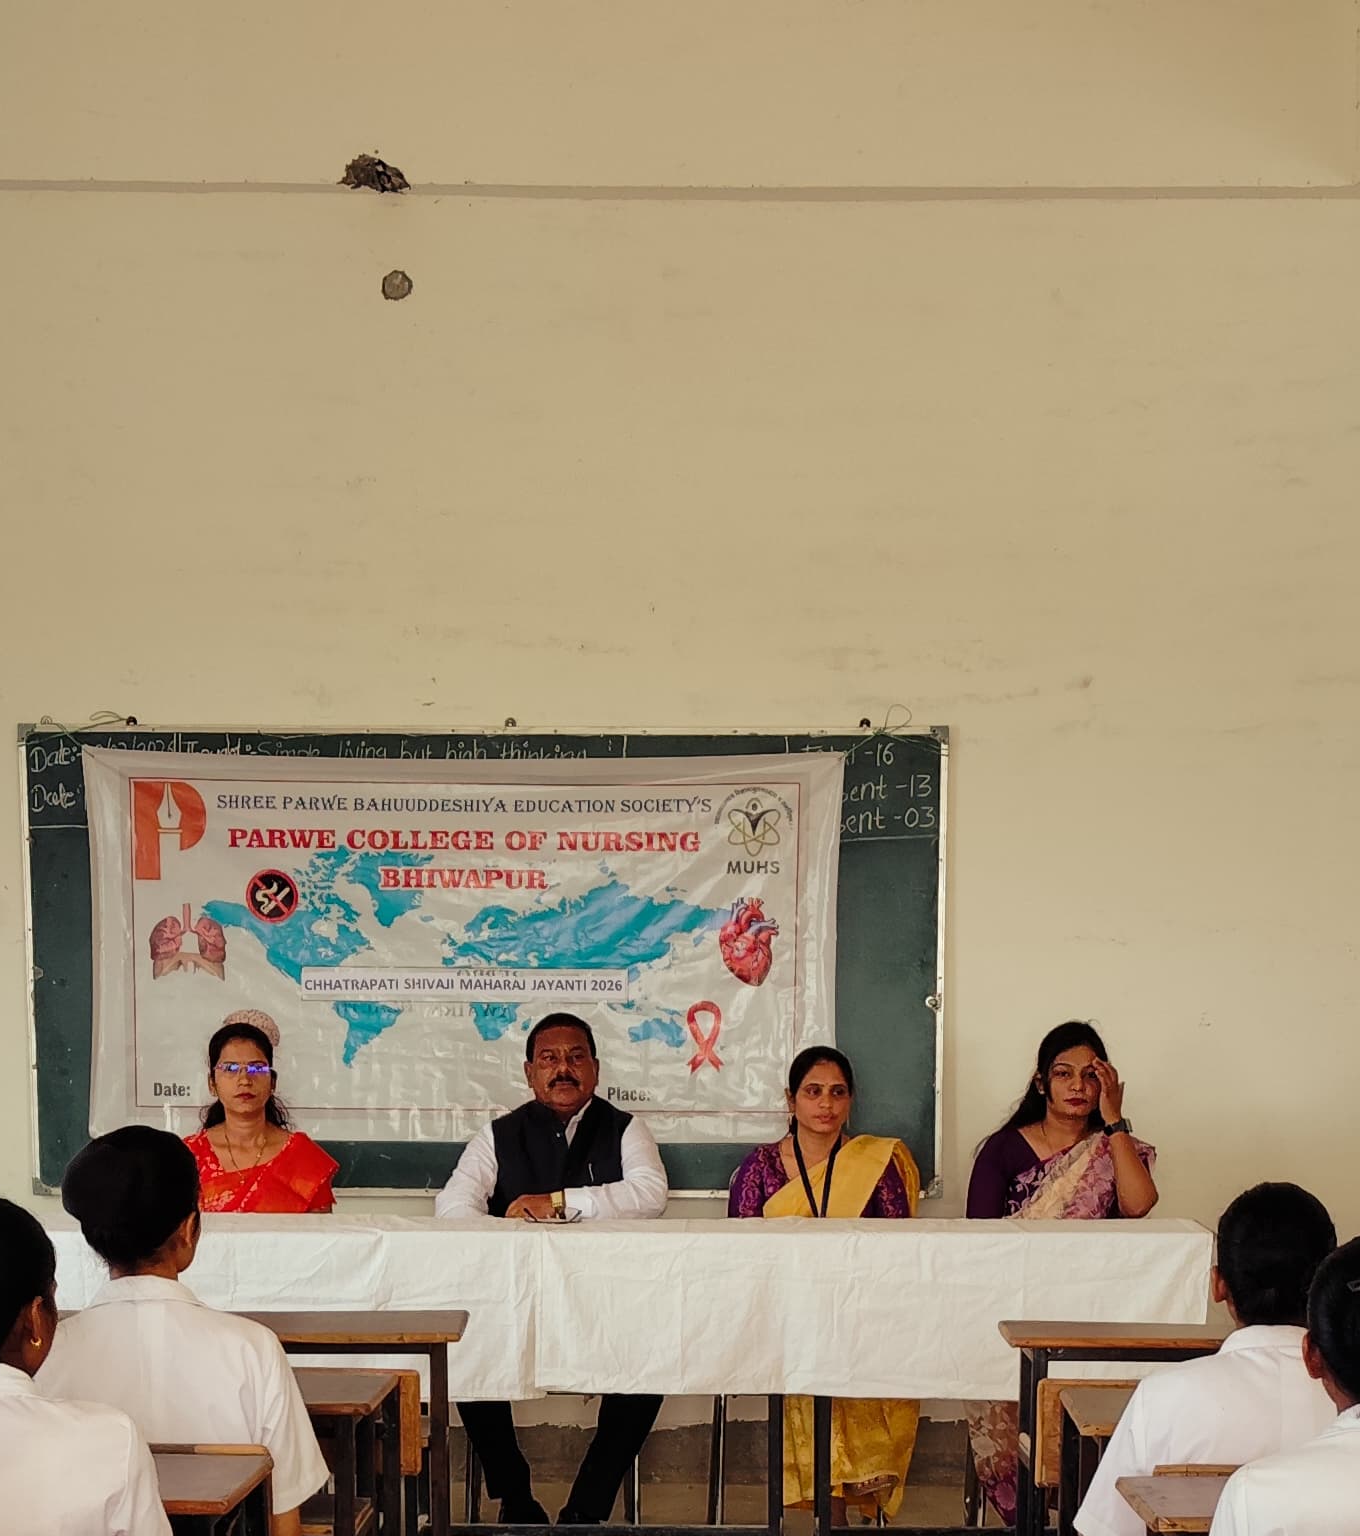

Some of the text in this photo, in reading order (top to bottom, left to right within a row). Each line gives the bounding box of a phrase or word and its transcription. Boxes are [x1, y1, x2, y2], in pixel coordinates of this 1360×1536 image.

[217, 795, 712, 812] SHREE PARWE BAHUUDDESHIYA EDUCATION SOCIETY'S
[228, 828, 701, 852] PARWE COLLEGE OF NURSING
[726, 860, 780, 874] MUHS
[379, 867, 549, 890] BHIWAPUR
[304, 979, 623, 991] CHHATRAPATI SHIVAJI MAHARAJ JAYANTI 2026
[153, 1082, 190, 1096] Date:
[607, 1087, 651, 1101] Place:
